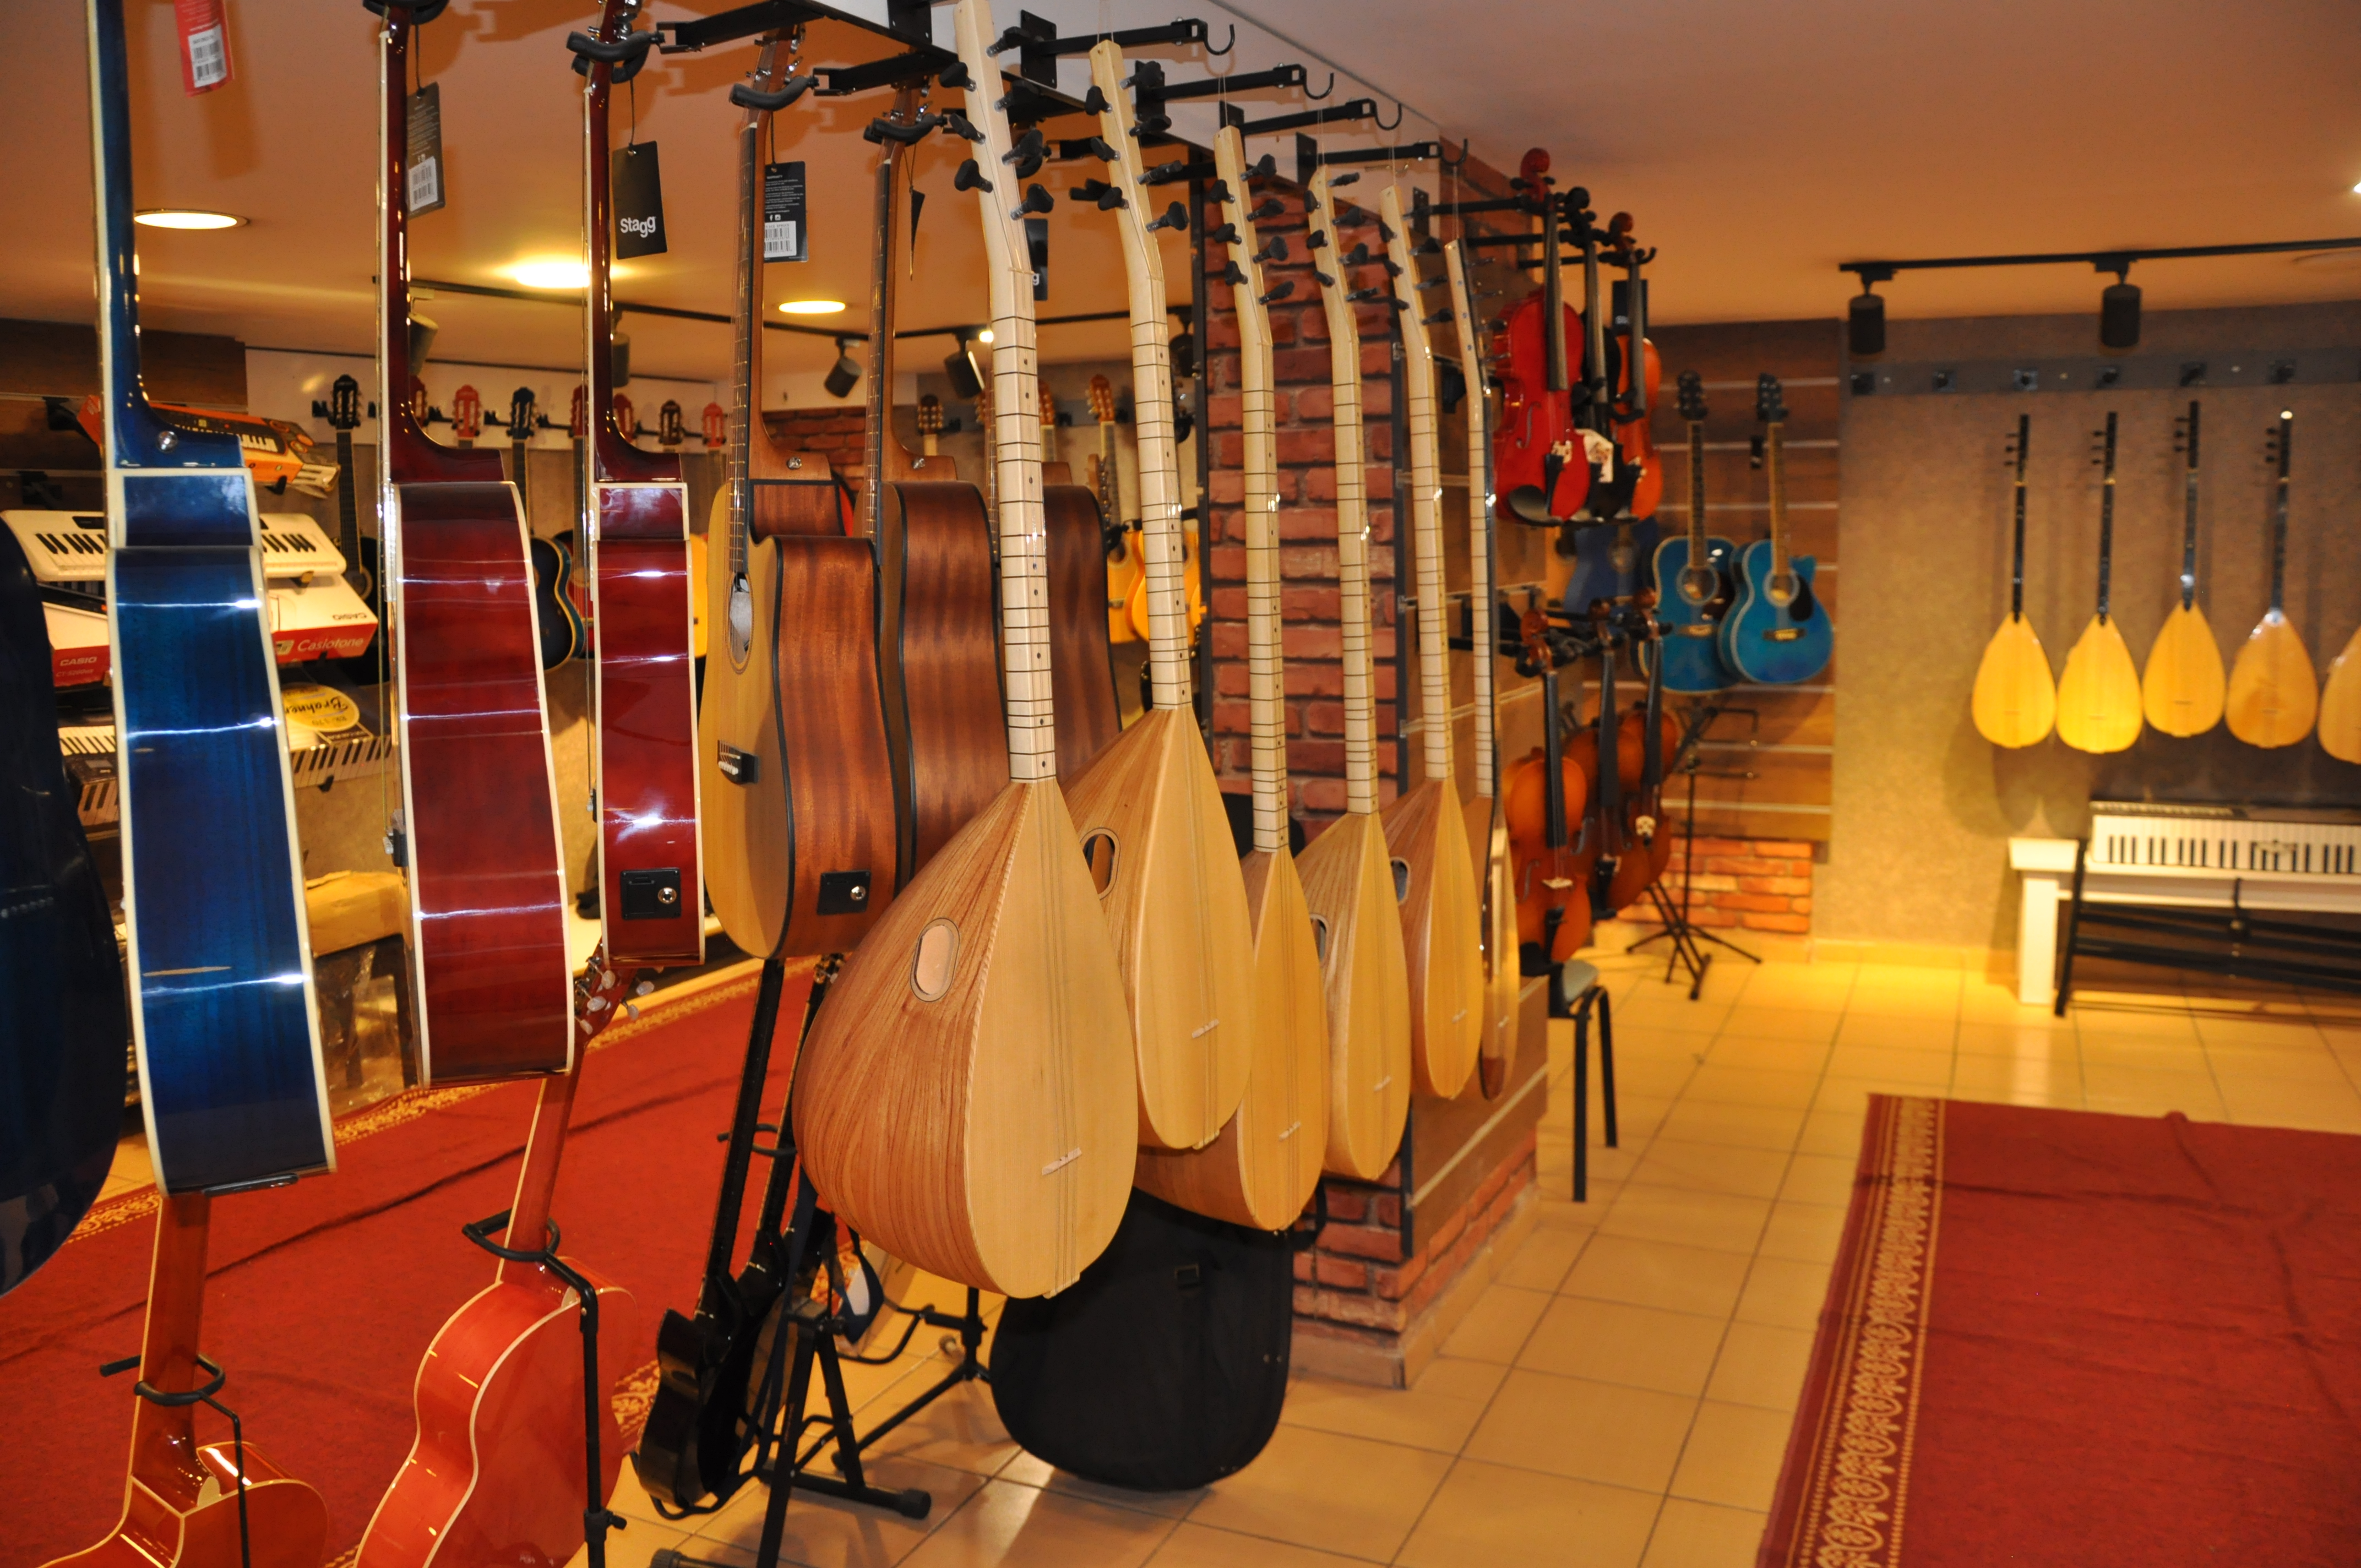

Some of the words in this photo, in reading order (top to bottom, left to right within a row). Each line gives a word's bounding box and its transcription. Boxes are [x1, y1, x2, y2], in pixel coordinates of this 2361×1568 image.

[620, 216, 656, 238] Stagg
[332, 612, 367, 621] CASIO
[297, 637, 365, 652] Casiotone
[59, 656, 97, 667] CASIO
